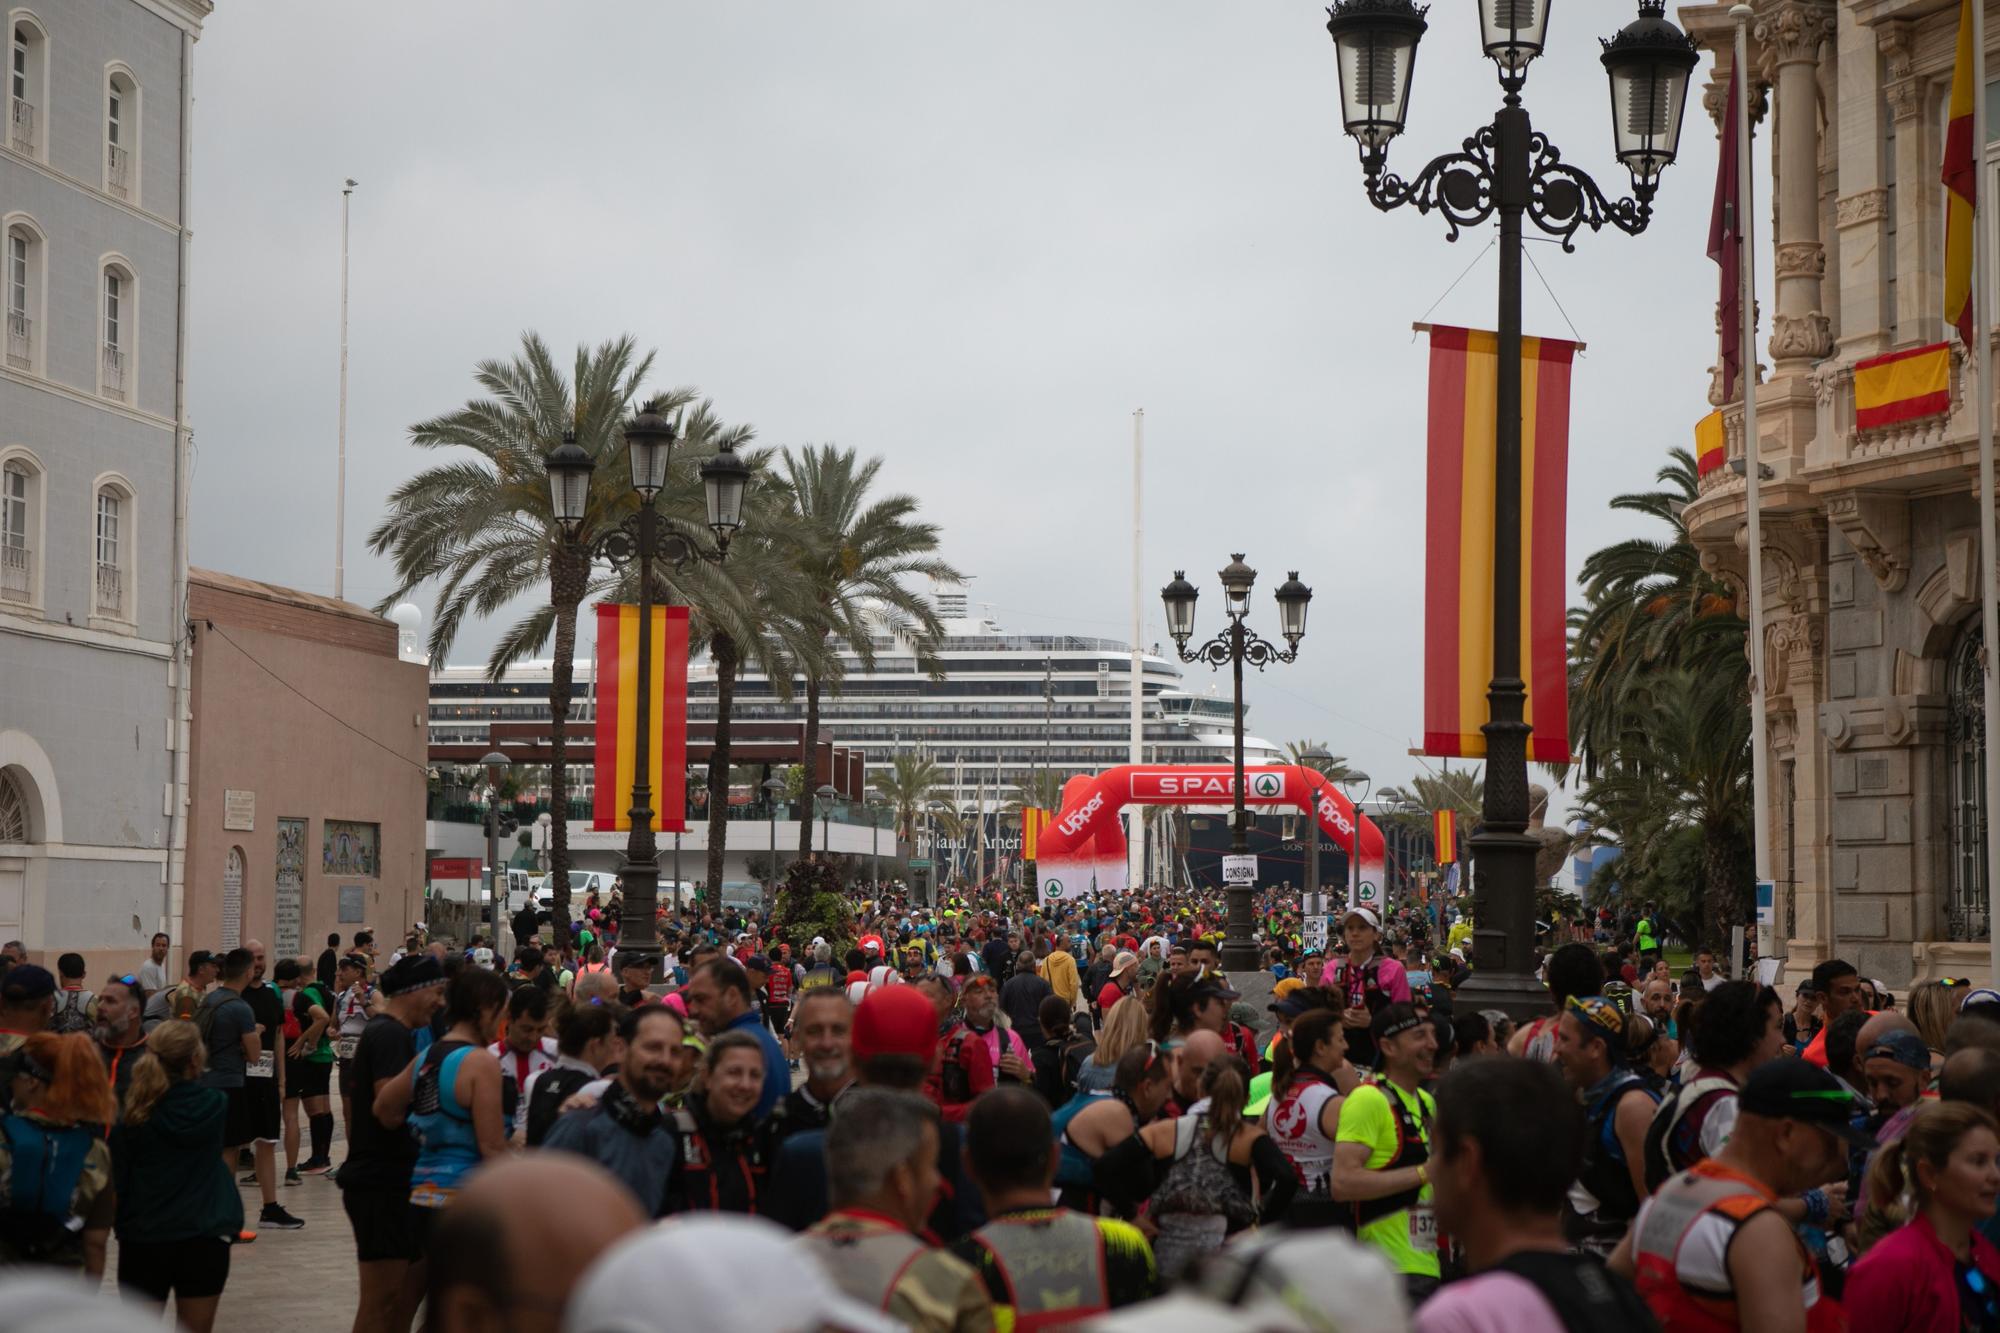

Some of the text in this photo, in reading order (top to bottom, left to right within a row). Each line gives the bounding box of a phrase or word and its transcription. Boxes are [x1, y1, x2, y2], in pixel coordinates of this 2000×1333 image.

[1225, 866, 1254, 879] CONSIGNA
[1304, 920, 1318, 932] WC
[1304, 937, 1318, 948] WC
